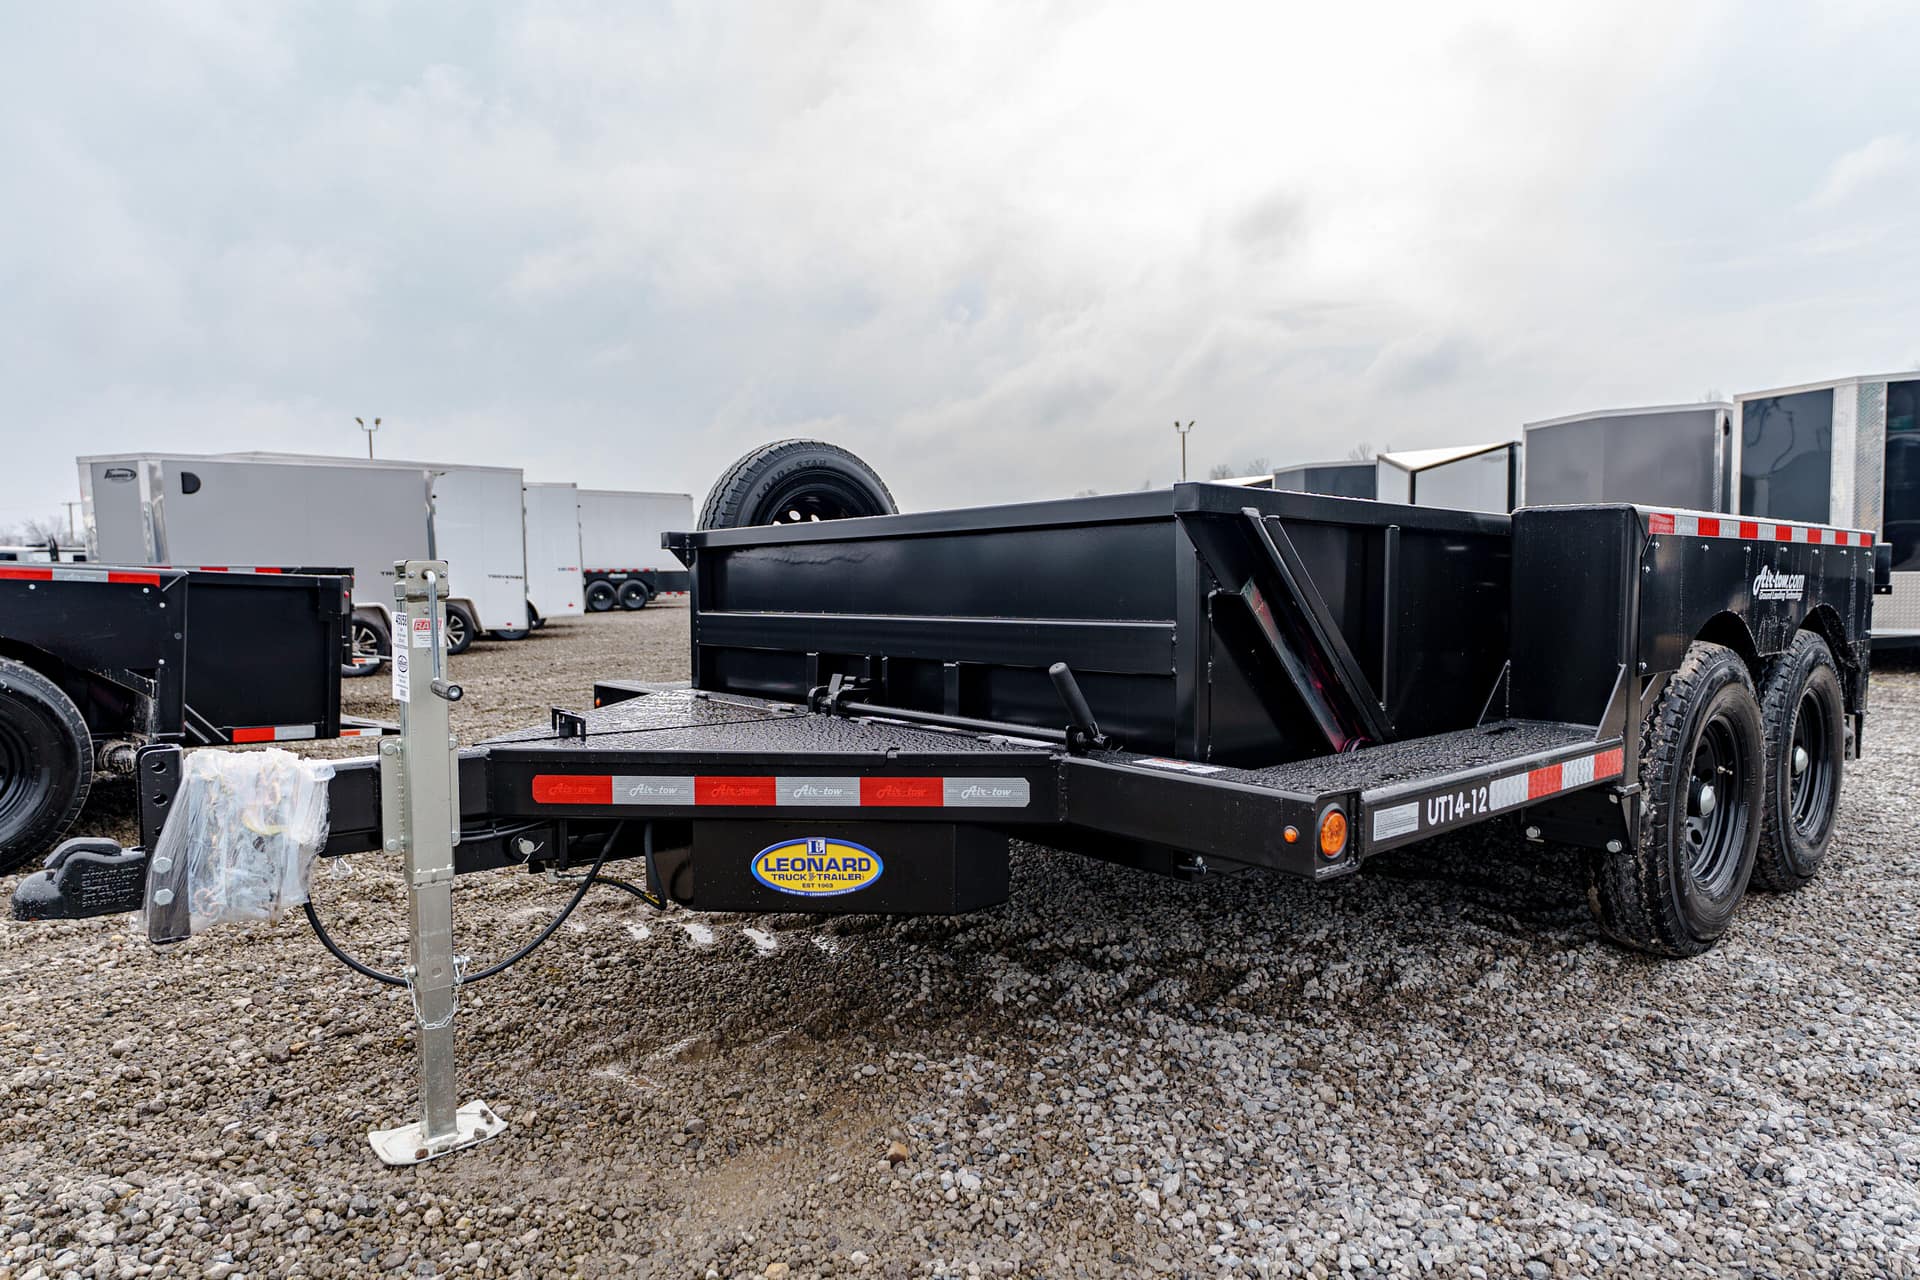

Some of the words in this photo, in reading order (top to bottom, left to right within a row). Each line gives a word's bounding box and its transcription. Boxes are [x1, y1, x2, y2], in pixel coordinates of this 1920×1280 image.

[1752, 564, 1805, 597] Air-tow.com
[630, 784, 678, 797] Air-tow
[793, 784, 843, 798] Air-tow
[960, 785, 1012, 799] Air-tow
[1427, 786, 1487, 826] UT14-12
[763, 857, 871, 872] LEONARD
[771, 873, 807, 881] TRUCK
[816, 873, 861, 881] TRAILER
